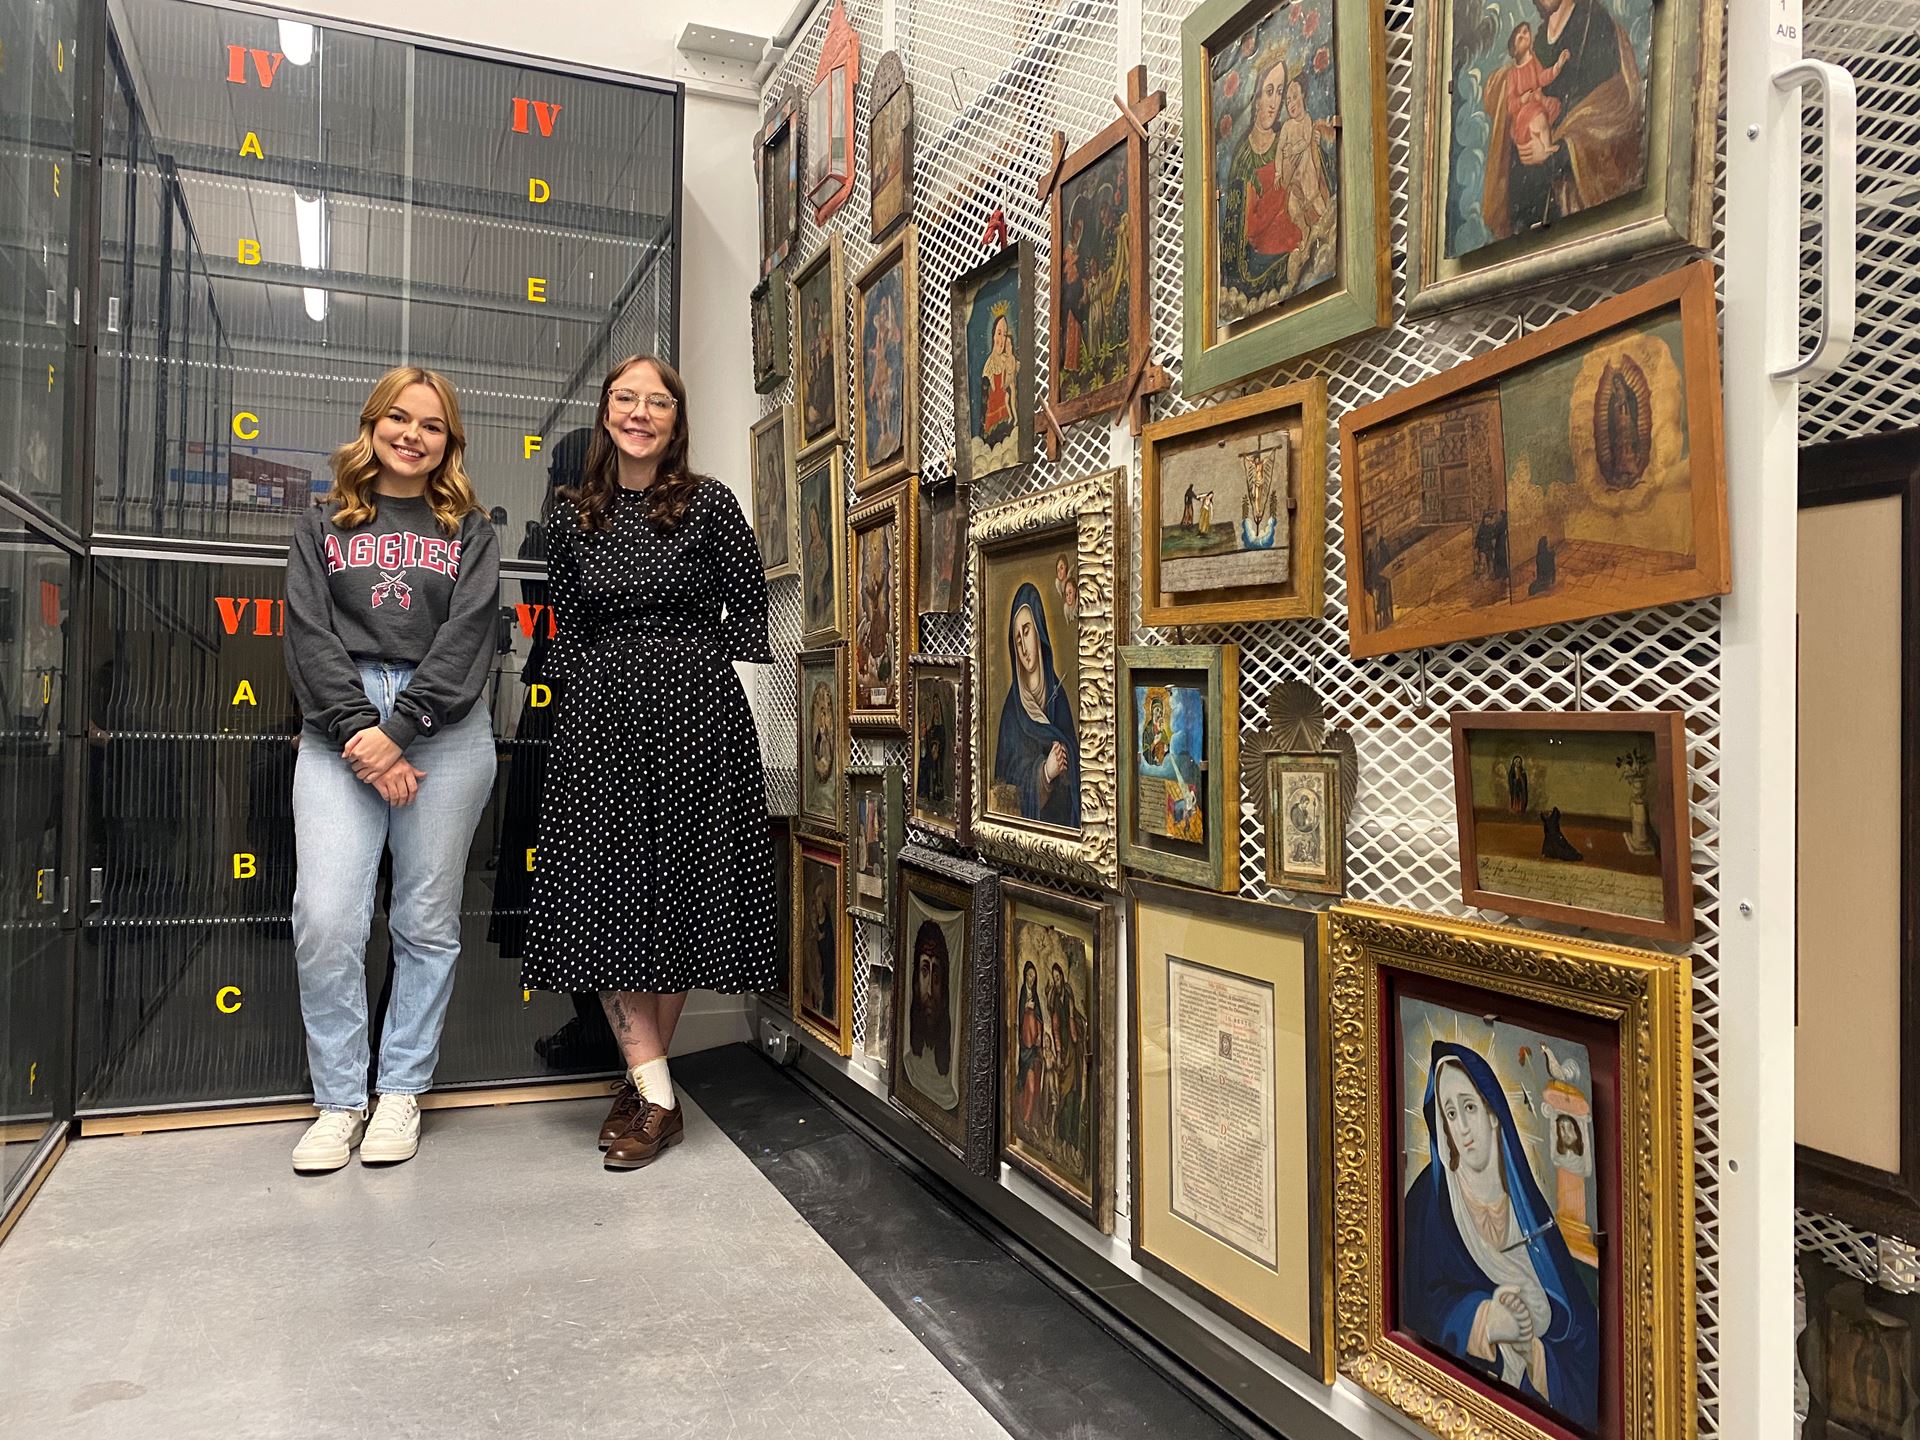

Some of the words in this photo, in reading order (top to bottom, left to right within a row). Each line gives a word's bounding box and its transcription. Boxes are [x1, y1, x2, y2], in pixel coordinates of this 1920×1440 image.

[1776, 23, 1797, 40] A/B
[226, 45, 284, 88] IV
[511, 97, 562, 137] IV
[239, 131, 264, 160] A
[528, 177, 551, 204] D
[237, 239, 261, 267] B
[527, 276, 547, 303] E
[232, 410, 259, 441] C
[523, 433, 543, 460] F
[324, 532, 463, 582] AGGIES
[231, 680, 257, 706] A
[530, 684, 552, 708] D
[233, 852, 256, 879] B
[215, 985, 241, 1014] C
